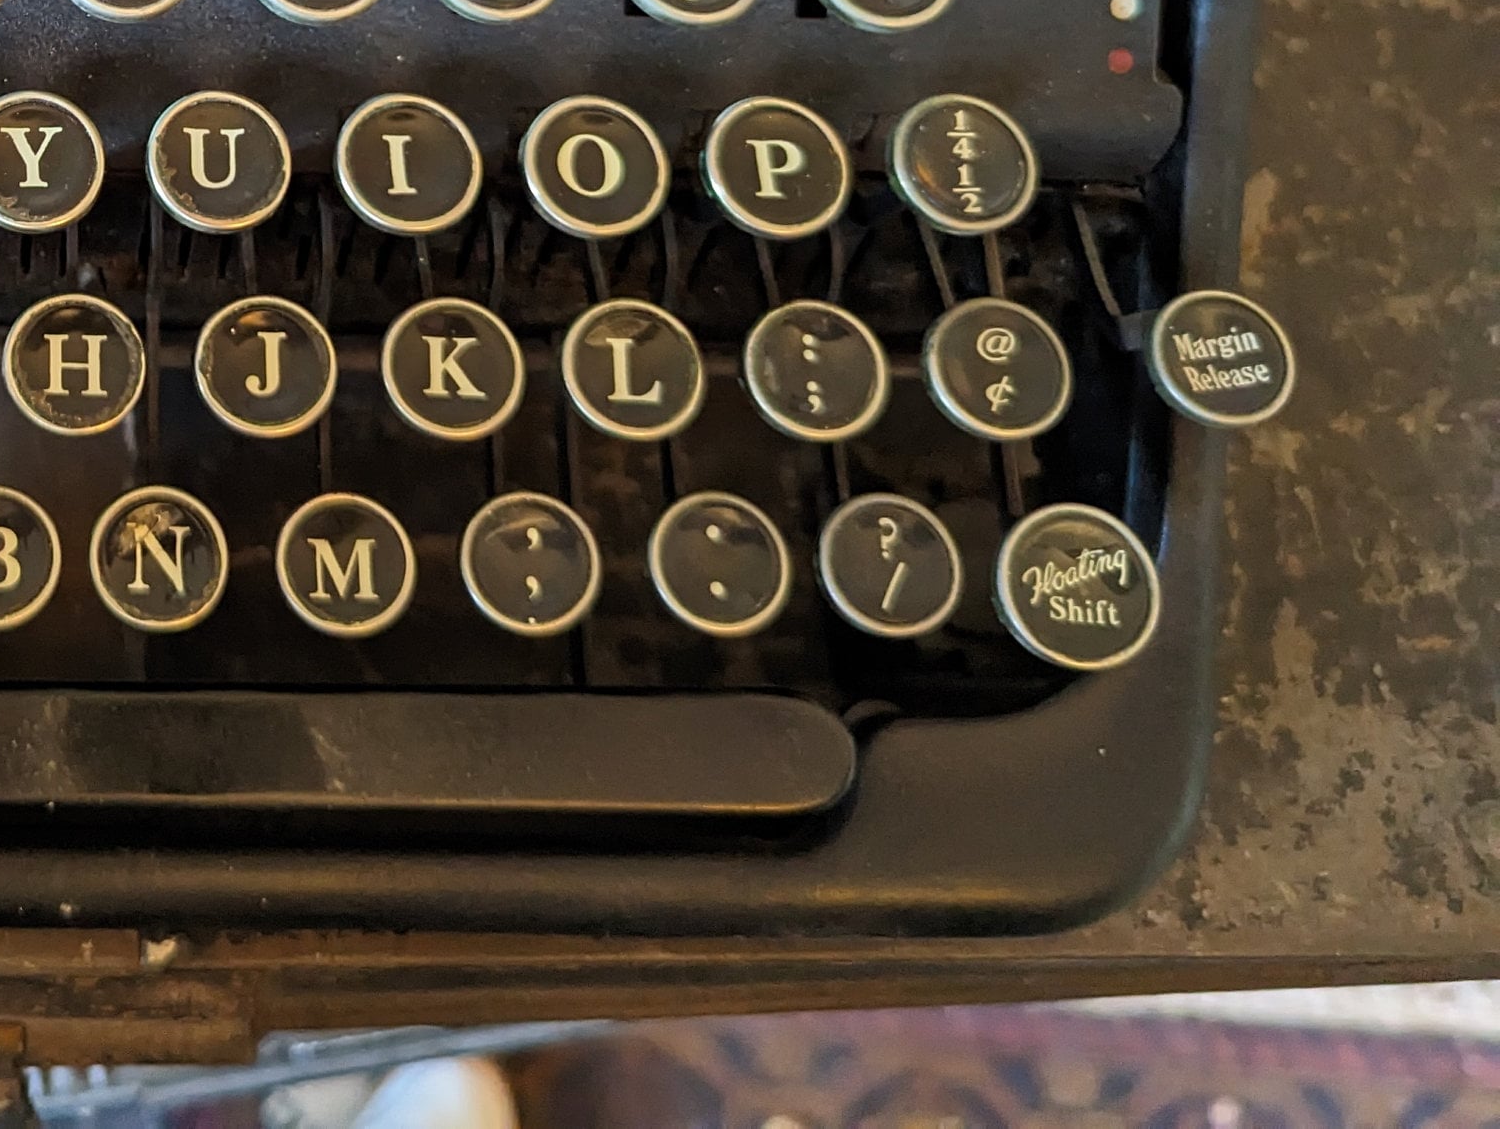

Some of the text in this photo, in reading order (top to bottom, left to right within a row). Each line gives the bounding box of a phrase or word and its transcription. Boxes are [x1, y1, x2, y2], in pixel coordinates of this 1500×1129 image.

[0, 126, 64, 189] Y
[183, 127, 246, 190] U
[381, 134, 418, 196] I
[556, 132, 625, 199] O
[746, 139, 803, 200] P
[43, 333, 108, 398] H
[245, 331, 288, 399] J
[422, 335, 489, 401] K
[605, 337, 662, 404] L
[975, 326, 1017, 361] @
[1172, 326, 1261, 362] Margin
[1183, 364, 1271, 392] Release
[126, 521, 191, 595] N
[307, 537, 381, 601] M
[878, 516, 898, 560] ?
[1022, 547, 1128, 605] Floating
[1049, 595, 1121, 628] Shift
